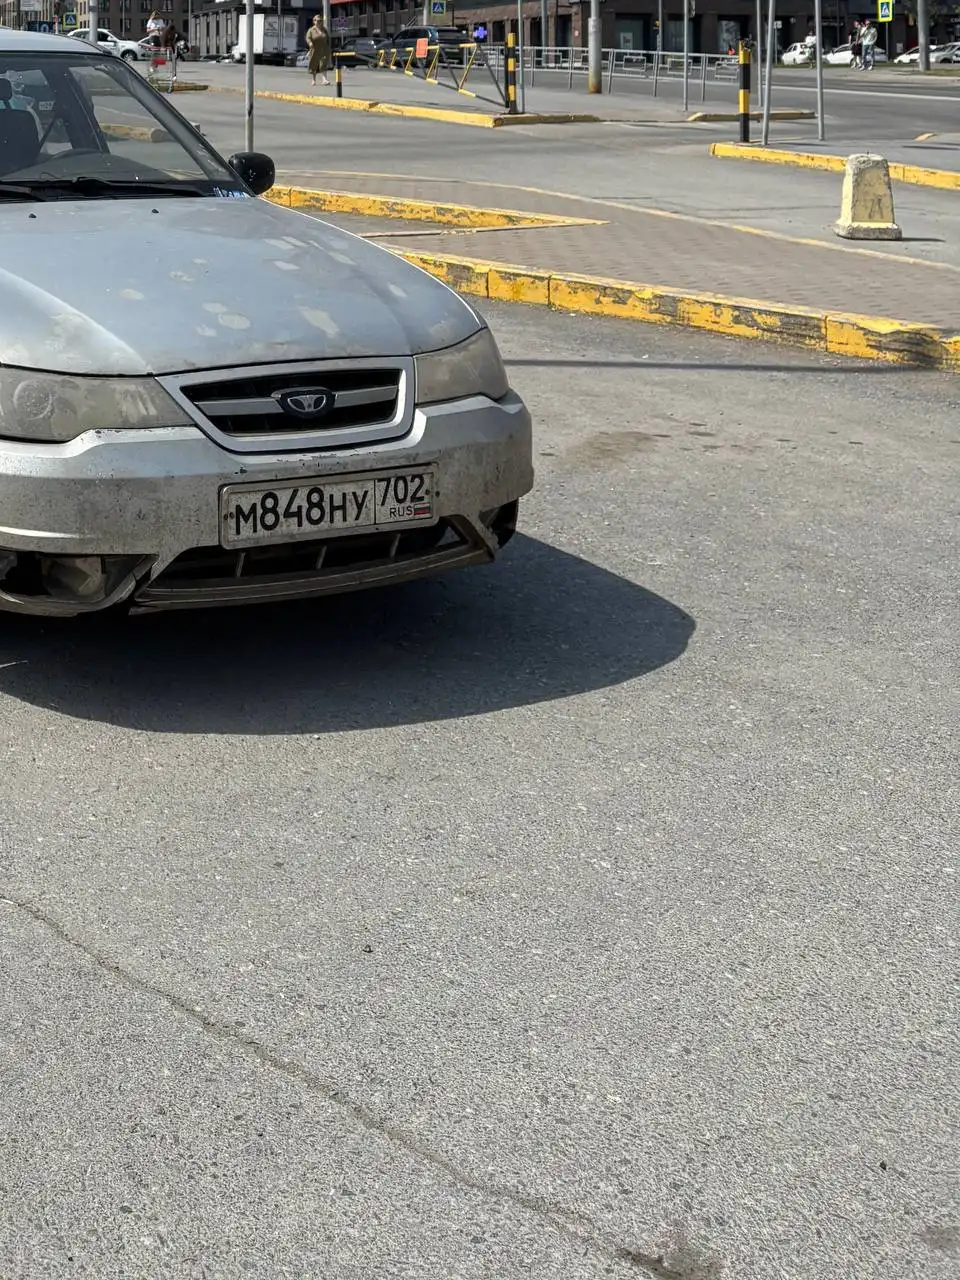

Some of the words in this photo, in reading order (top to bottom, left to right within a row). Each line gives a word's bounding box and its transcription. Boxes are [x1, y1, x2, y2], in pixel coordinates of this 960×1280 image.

[235, 486, 368, 535] М848НУ
[377, 474, 425, 507] 702
[390, 505, 413, 518] RUS
